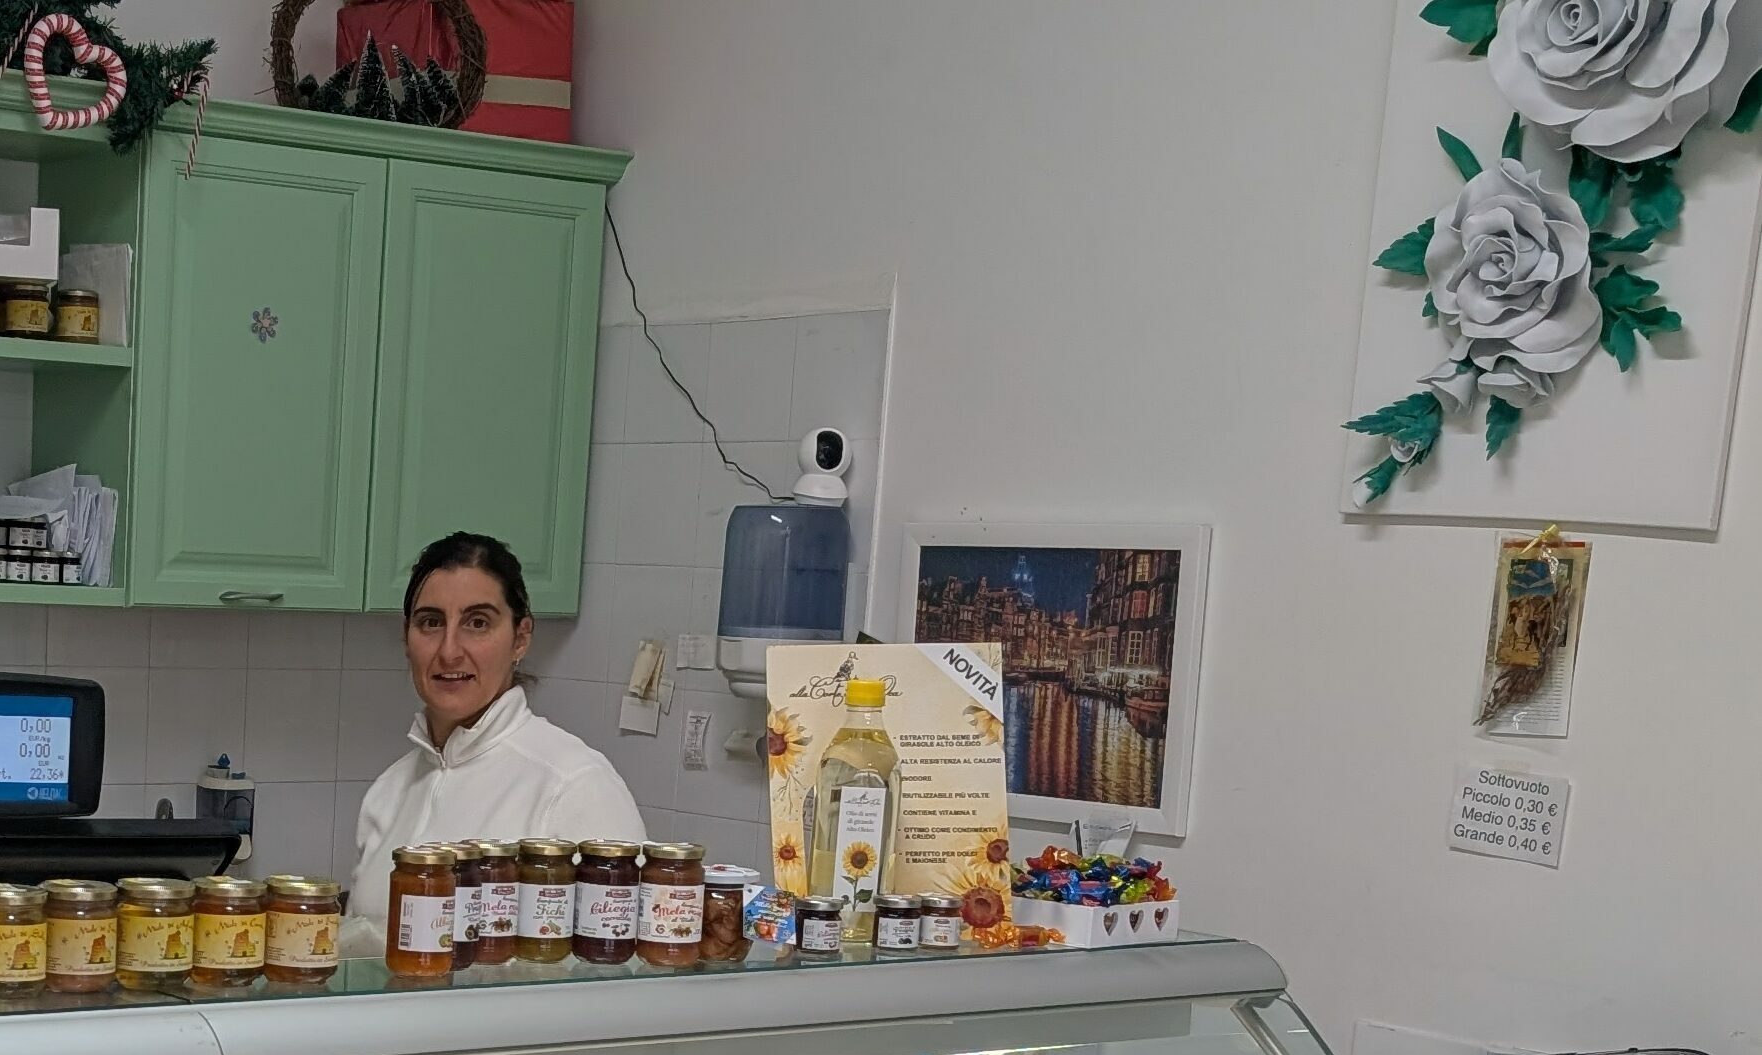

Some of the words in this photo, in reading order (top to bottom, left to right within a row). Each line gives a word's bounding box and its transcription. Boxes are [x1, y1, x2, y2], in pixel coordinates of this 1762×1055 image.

[942, 648, 1000, 700] NOVITÀ
[21, 718, 51, 732] 0,00
[20, 743, 50, 757] 0,00
[1479, 770, 1549, 795] Sottovuoto
[1462, 787, 1510, 807] Piccolo
[1515, 797, 1543, 814] 0,30
[1548, 804, 1558, 817] €
[1461, 806, 1503, 825] Medio
[1507, 815, 1536, 832] 0,35
[1542, 822, 1551, 835] €
[1454, 824, 1504, 845] Grande
[1508, 835, 1537, 851] 0,40
[1542, 842, 1551, 855] €
[536, 903, 566, 916] Fichi
[658, 905, 685, 917] Mela
